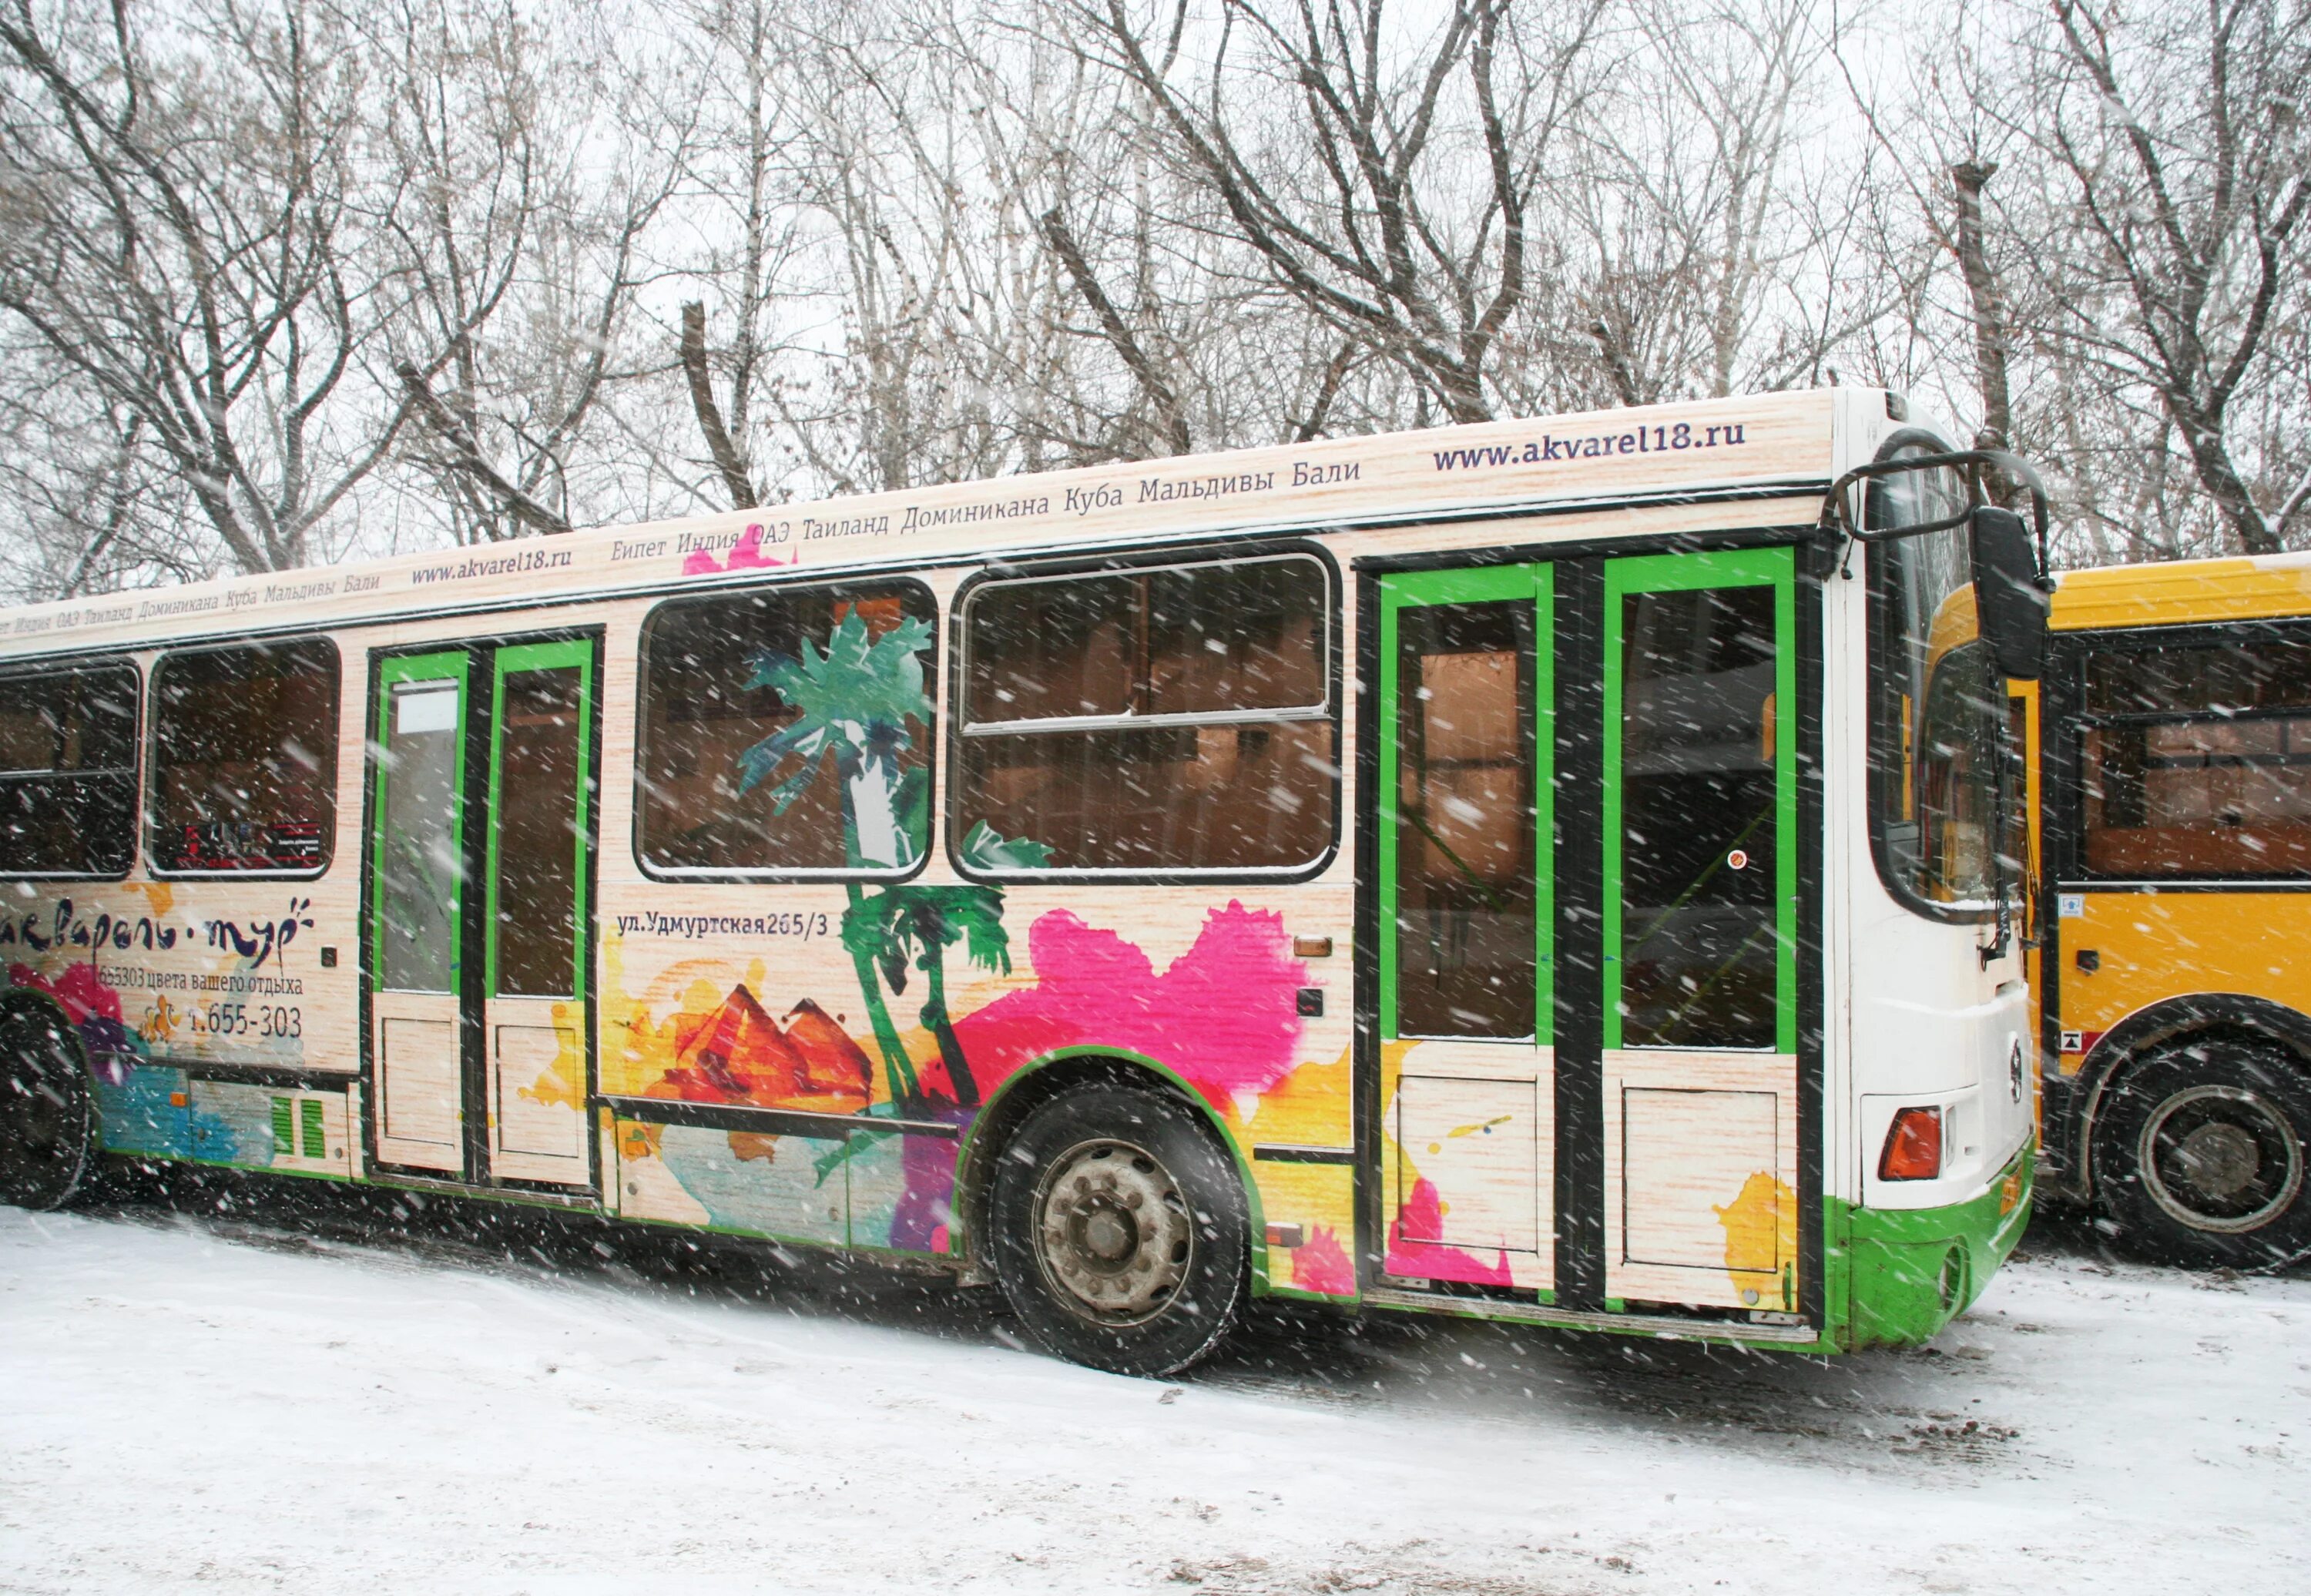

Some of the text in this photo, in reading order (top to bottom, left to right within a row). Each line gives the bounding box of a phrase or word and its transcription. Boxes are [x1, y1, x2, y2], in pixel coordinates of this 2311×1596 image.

[1433, 422, 1746, 471] www.akvarel18.ru
[676, 532, 740, 554] Индия
[751, 521, 790, 545] ОАЭ
[802, 515, 888, 540] Таиланд
[900, 497, 1049, 535] Доминикана
[1062, 482, 1123, 516] Куба
[1137, 471, 1275, 502] Мальдивы
[1290, 461, 1361, 487] Бали
[412, 550, 572, 584] www.akvarel18.ru
[137, 601, 219, 622] Доминикана
[226, 587, 258, 611] Куба
[263, 581, 336, 603] Мальдивы
[344, 575, 381, 593] Бали
[147, 972, 186, 991] цвета
[191, 974, 244, 992] вашего
[248, 977, 304, 997] отдыха
